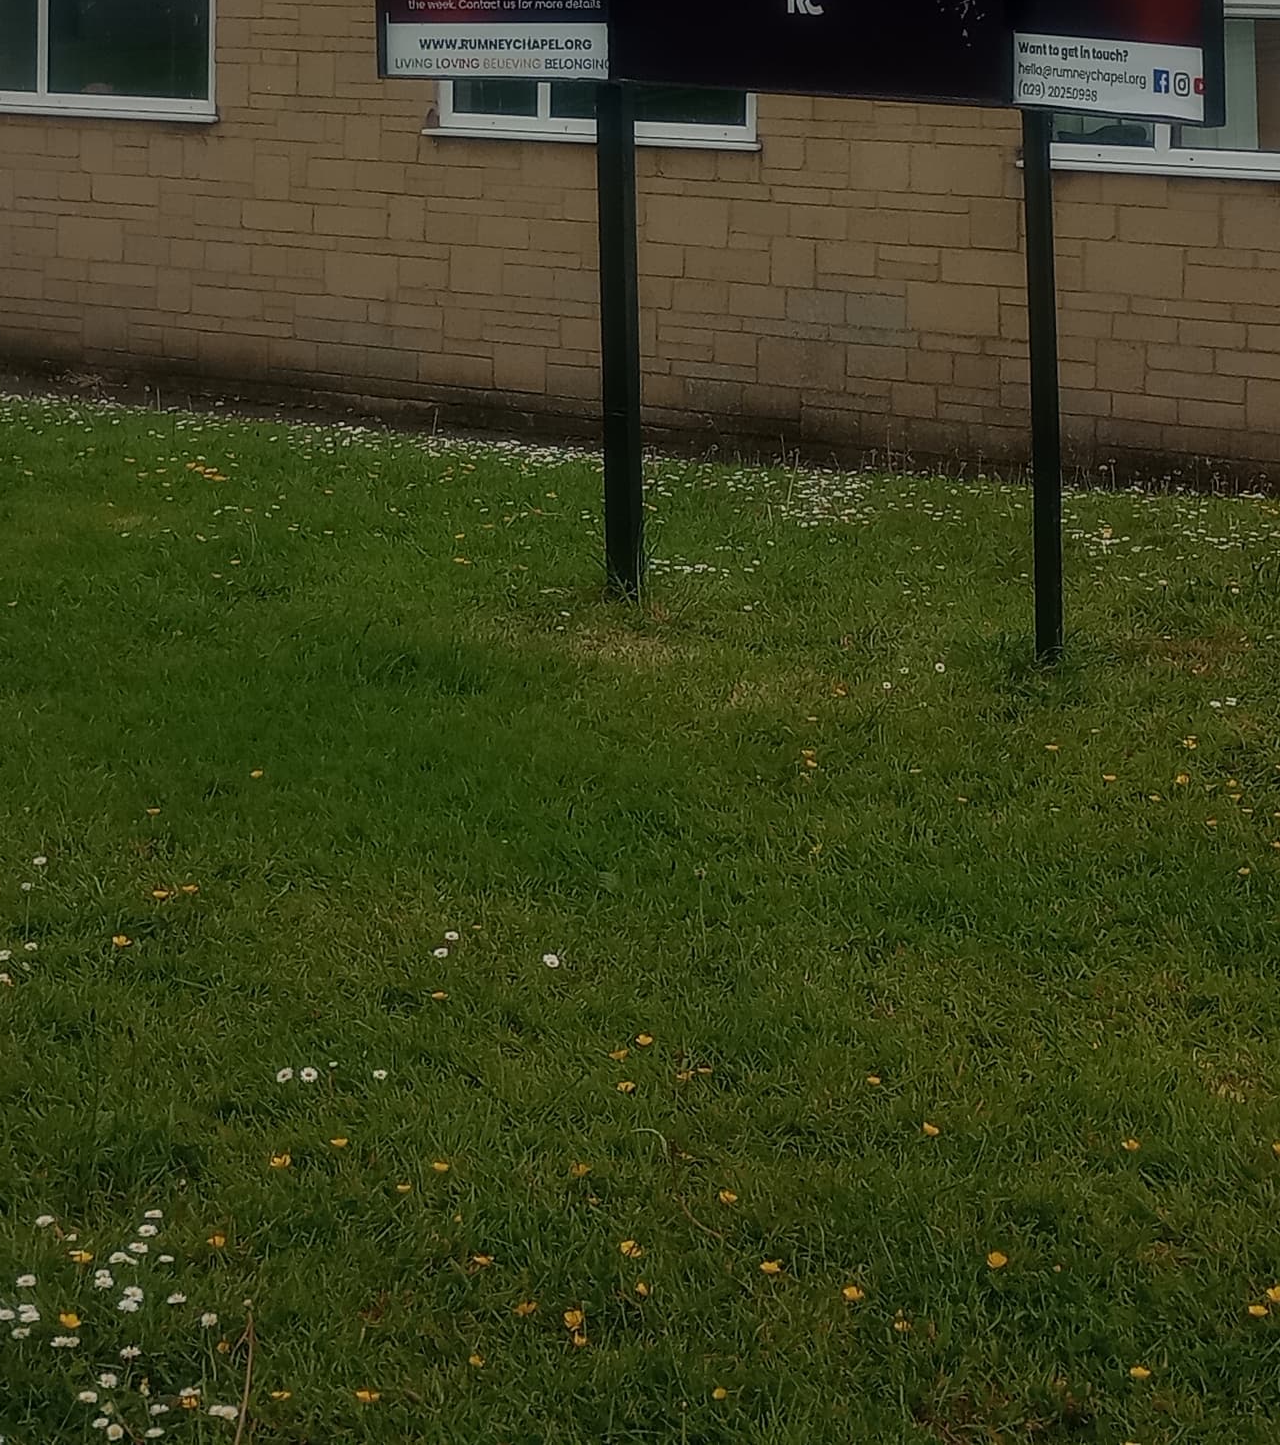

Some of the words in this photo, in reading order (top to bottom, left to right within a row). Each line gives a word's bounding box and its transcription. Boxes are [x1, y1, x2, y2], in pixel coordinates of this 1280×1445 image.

[408, 0, 425, 10] the
[503, 0, 517, 11] us
[534, 0, 564, 10] more
[419, 37, 592, 51] WWW.RUMNEYCHAPEL.ORG
[1018, 41, 1047, 57] Want
[1048, 45, 1060, 57] to
[1061, 46, 1079, 61] get
[1080, 45, 1091, 60] in
[1092, 47, 1129, 63] touch?
[395, 57, 433, 69] LIVING
[436, 57, 480, 69] LOVING
[483, 58, 541, 69] BELIEVING
[1018, 61, 1147, 89] hello@rumneychapel.org
[1018, 80, 1046, 99] (029)
